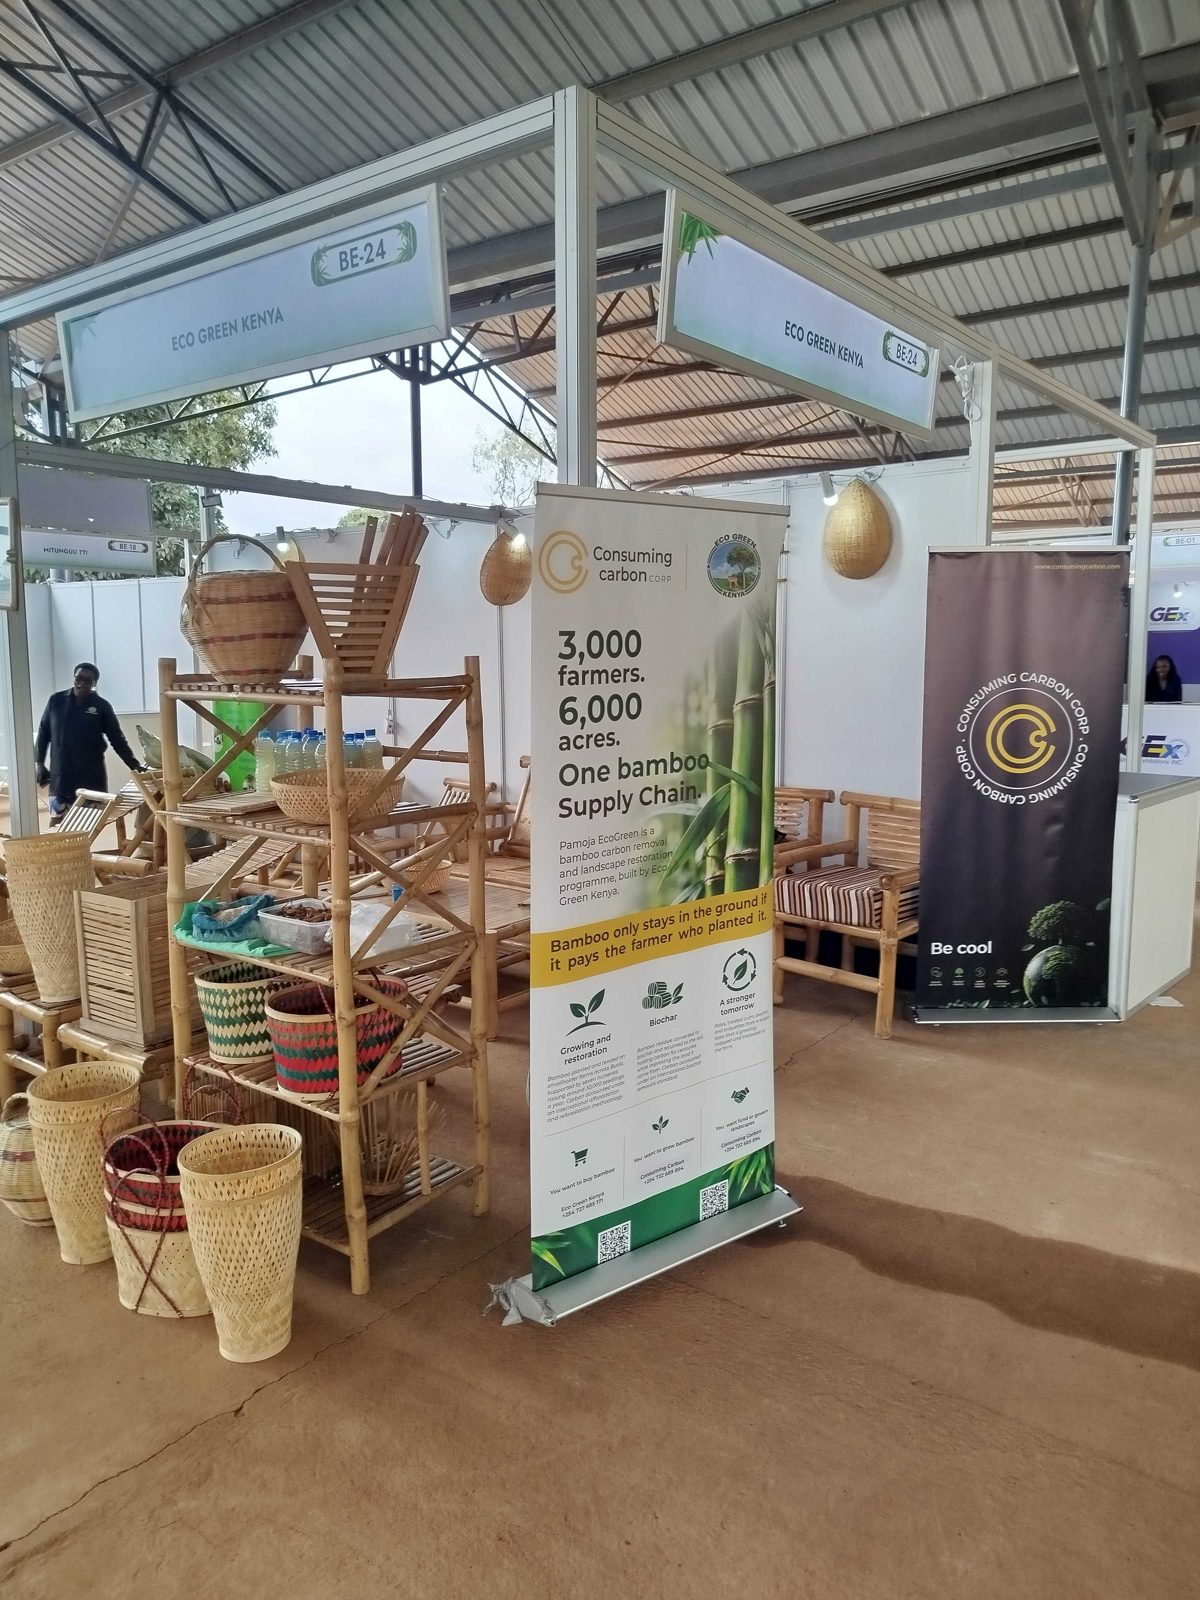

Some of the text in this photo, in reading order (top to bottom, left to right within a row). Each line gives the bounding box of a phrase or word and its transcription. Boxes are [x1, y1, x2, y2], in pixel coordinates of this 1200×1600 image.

[339, 238, 386, 272] BE-24
[172, 307, 284, 351] ECO GREEN KENYA
[785, 320, 863, 368] ECO GREEN KENYA
[896, 344, 918, 366] BE-24
[44, 547, 77, 555] MITUNGUU
[120, 543, 136, 551] BE-18
[714, 534, 757, 549] ECO GREEN
[593, 546, 672, 567] Consuming
[1035, 563, 1120, 571] www.consumingcarbon.com
[599, 567, 647, 582] carbon
[558, 630, 642, 665] 3,000
[558, 665, 644, 686] farmers.
[559, 692, 642, 729] 6,000
[957, 672, 1089, 734] CONSUMING CARBON CORP
[559, 732, 620, 751] acres.
[559, 752, 709, 786] One bamboo
[956, 744, 1088, 804] CONSUMING CARBON CORP
[558, 781, 702, 819] Supply Chain.
[560, 837, 595, 850] Pamoja
[599, 830, 638, 844] EcoGreen
[641, 828, 647, 836] is
[560, 838, 667, 864] bamboo carbon removal
[560, 851, 672, 878] and landscape restoration
[560, 865, 667, 894] programme, built by Eco
[560, 888, 619, 906] Green Kenya.
[551, 893, 767, 953] Bamboo only stays in the ground if
[550, 910, 767, 971] it pays the farmer who planted it.
[931, 941, 992, 954] Be cool
[721, 1003, 754, 1015] tomorrow
[727, 993, 756, 1004] stronger
[649, 1014, 677, 1027] Biochar
[560, 1033, 611, 1055] Growing and
[564, 1046, 607, 1065] restoration
[562, 1183, 575, 1191] want
[594, 1168, 615, 1179] bamboo
[572, 1199, 588, 1208] Green
[589, 1191, 605, 1201] Kenya
